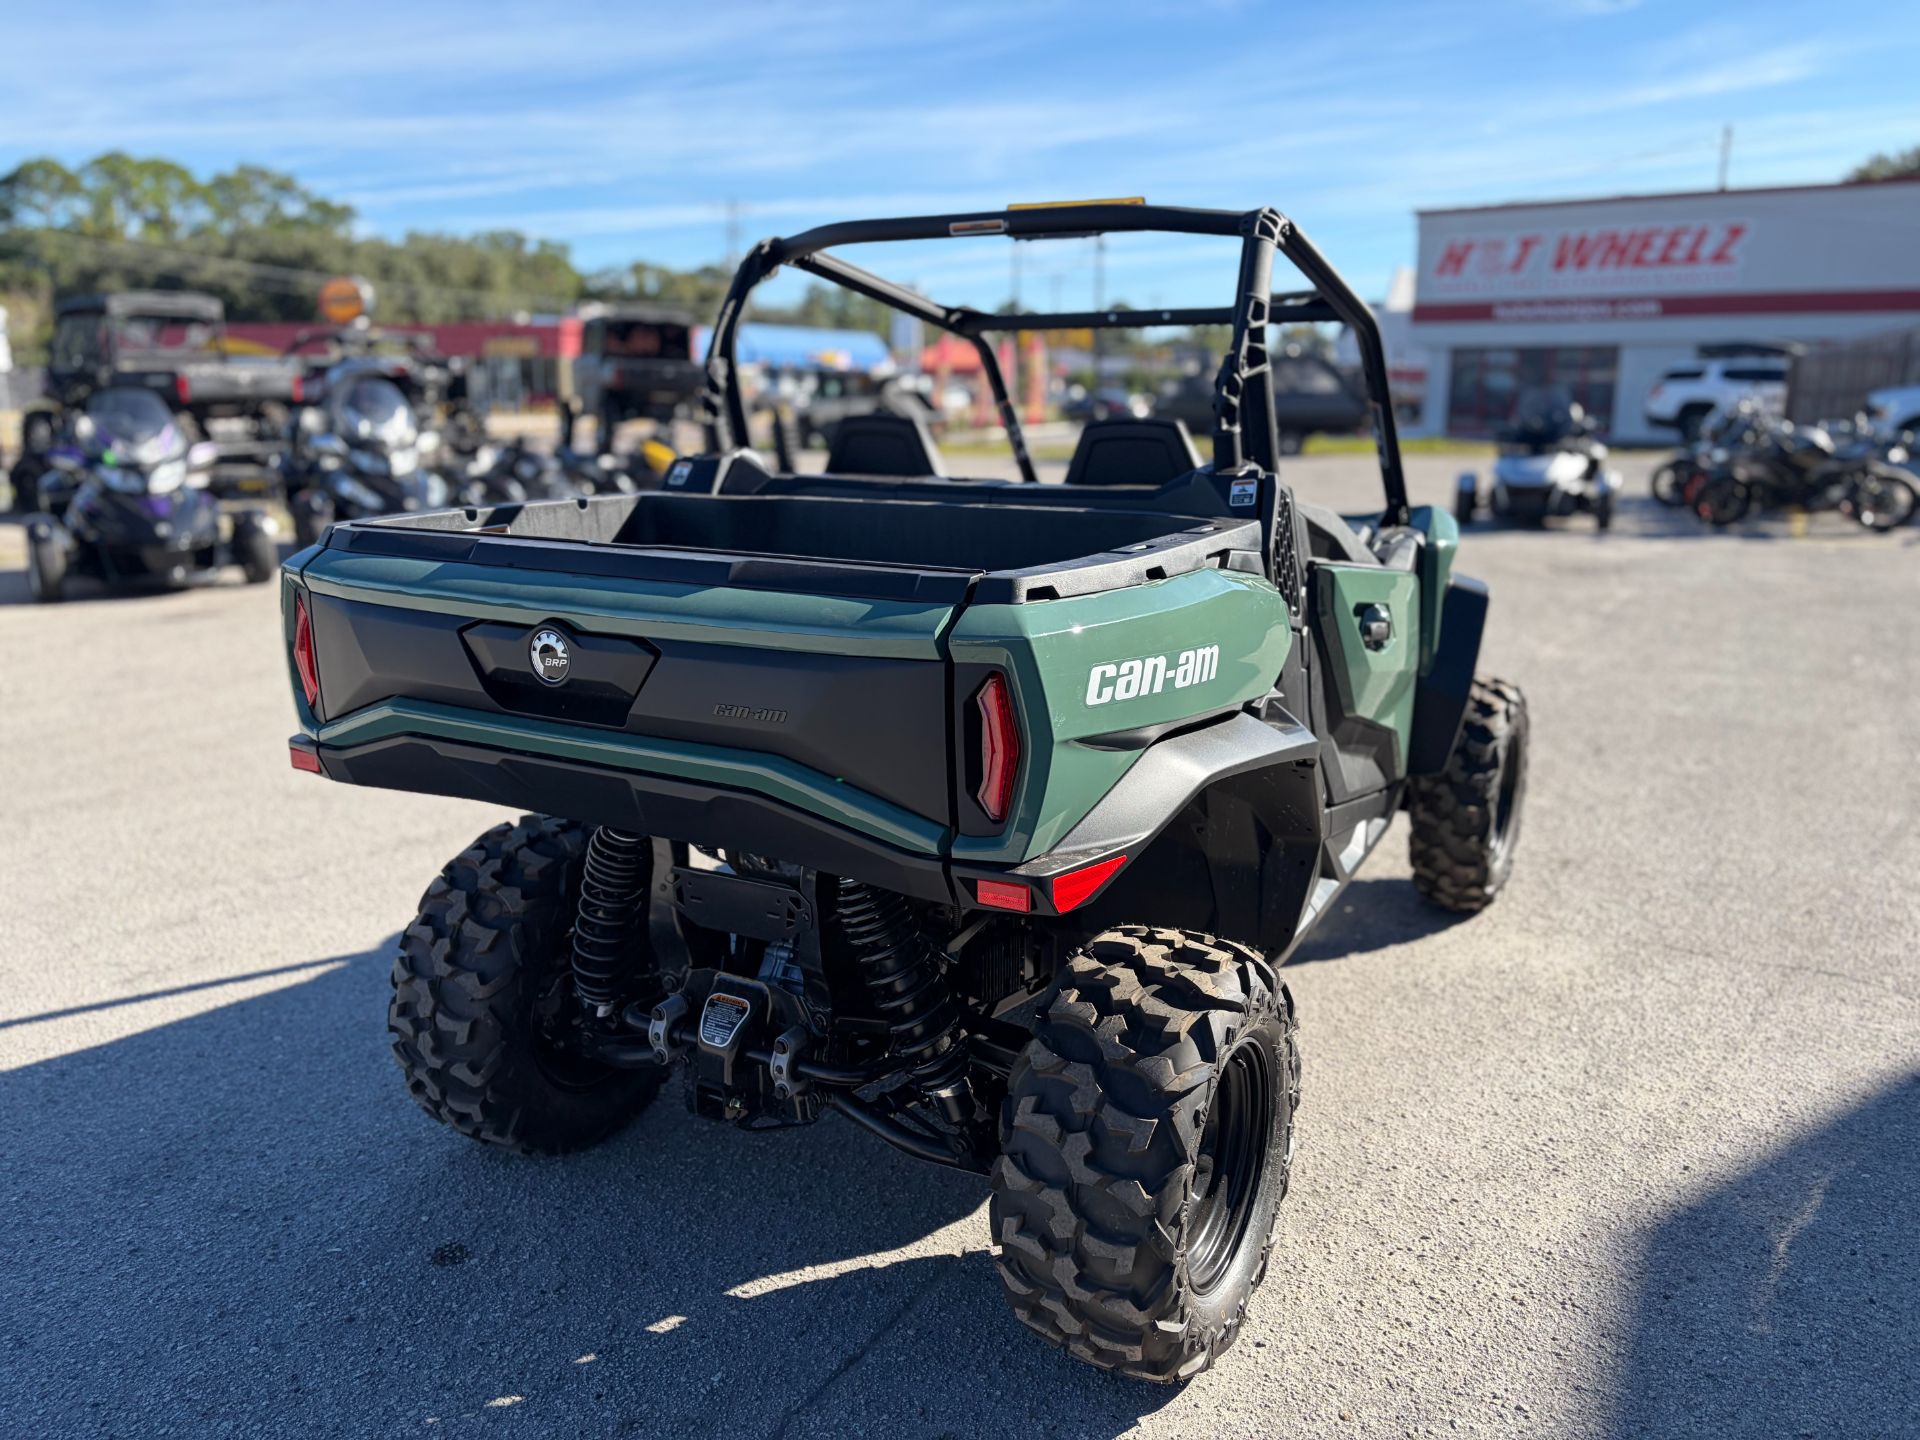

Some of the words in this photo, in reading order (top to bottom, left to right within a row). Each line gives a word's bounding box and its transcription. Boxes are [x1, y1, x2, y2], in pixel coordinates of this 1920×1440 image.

[1551, 222, 1748, 272] WHEELZ
[545, 657, 567, 668] BRP
[1085, 644, 1219, 706] can-am
[713, 704, 787, 722] can-am
